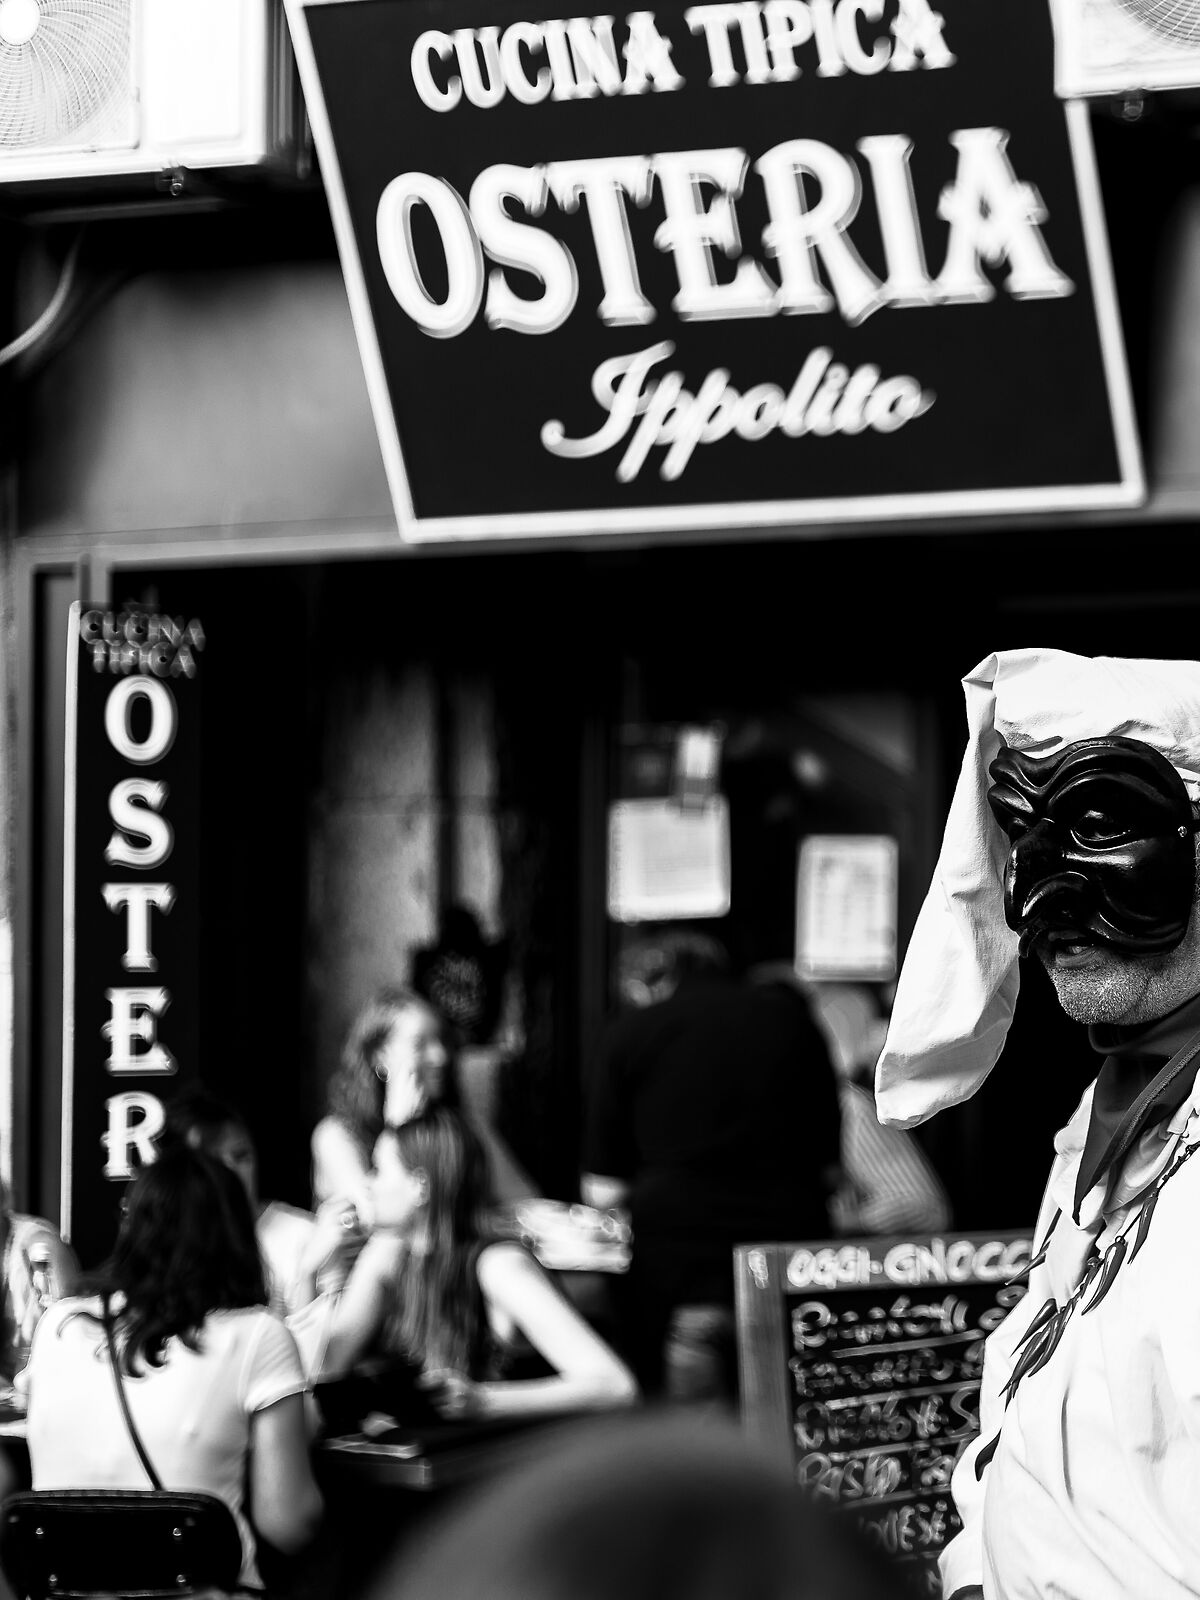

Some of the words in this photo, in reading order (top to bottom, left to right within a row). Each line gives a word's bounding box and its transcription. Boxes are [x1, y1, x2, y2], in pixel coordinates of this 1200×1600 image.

[411, 11, 686, 113] CUCINA
[684, 0, 958, 88] TIPICA
[376, 127, 1075, 339] OSTERIA
[540, 340, 936, 483] Ippolito
[80, 609, 207, 653] CUCINA
[92, 639, 198, 680] TIPICA
[101, 673, 180, 1183] OSTER
